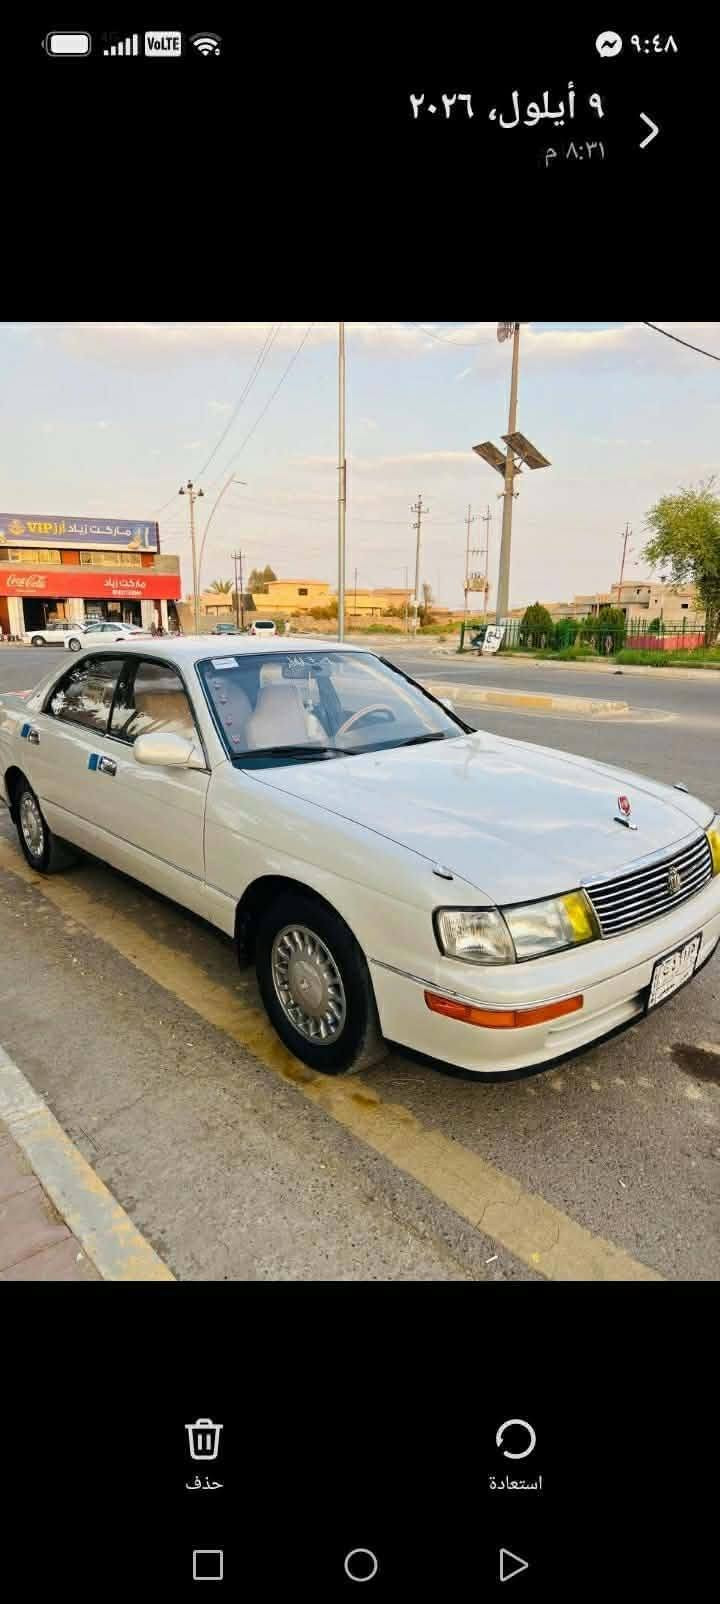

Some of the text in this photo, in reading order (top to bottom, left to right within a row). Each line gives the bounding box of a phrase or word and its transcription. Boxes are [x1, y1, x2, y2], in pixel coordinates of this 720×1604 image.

[27, 521, 53, 533] VIP
[67, 522, 88, 536] زياد
[89, 525, 132, 537] ماركت
